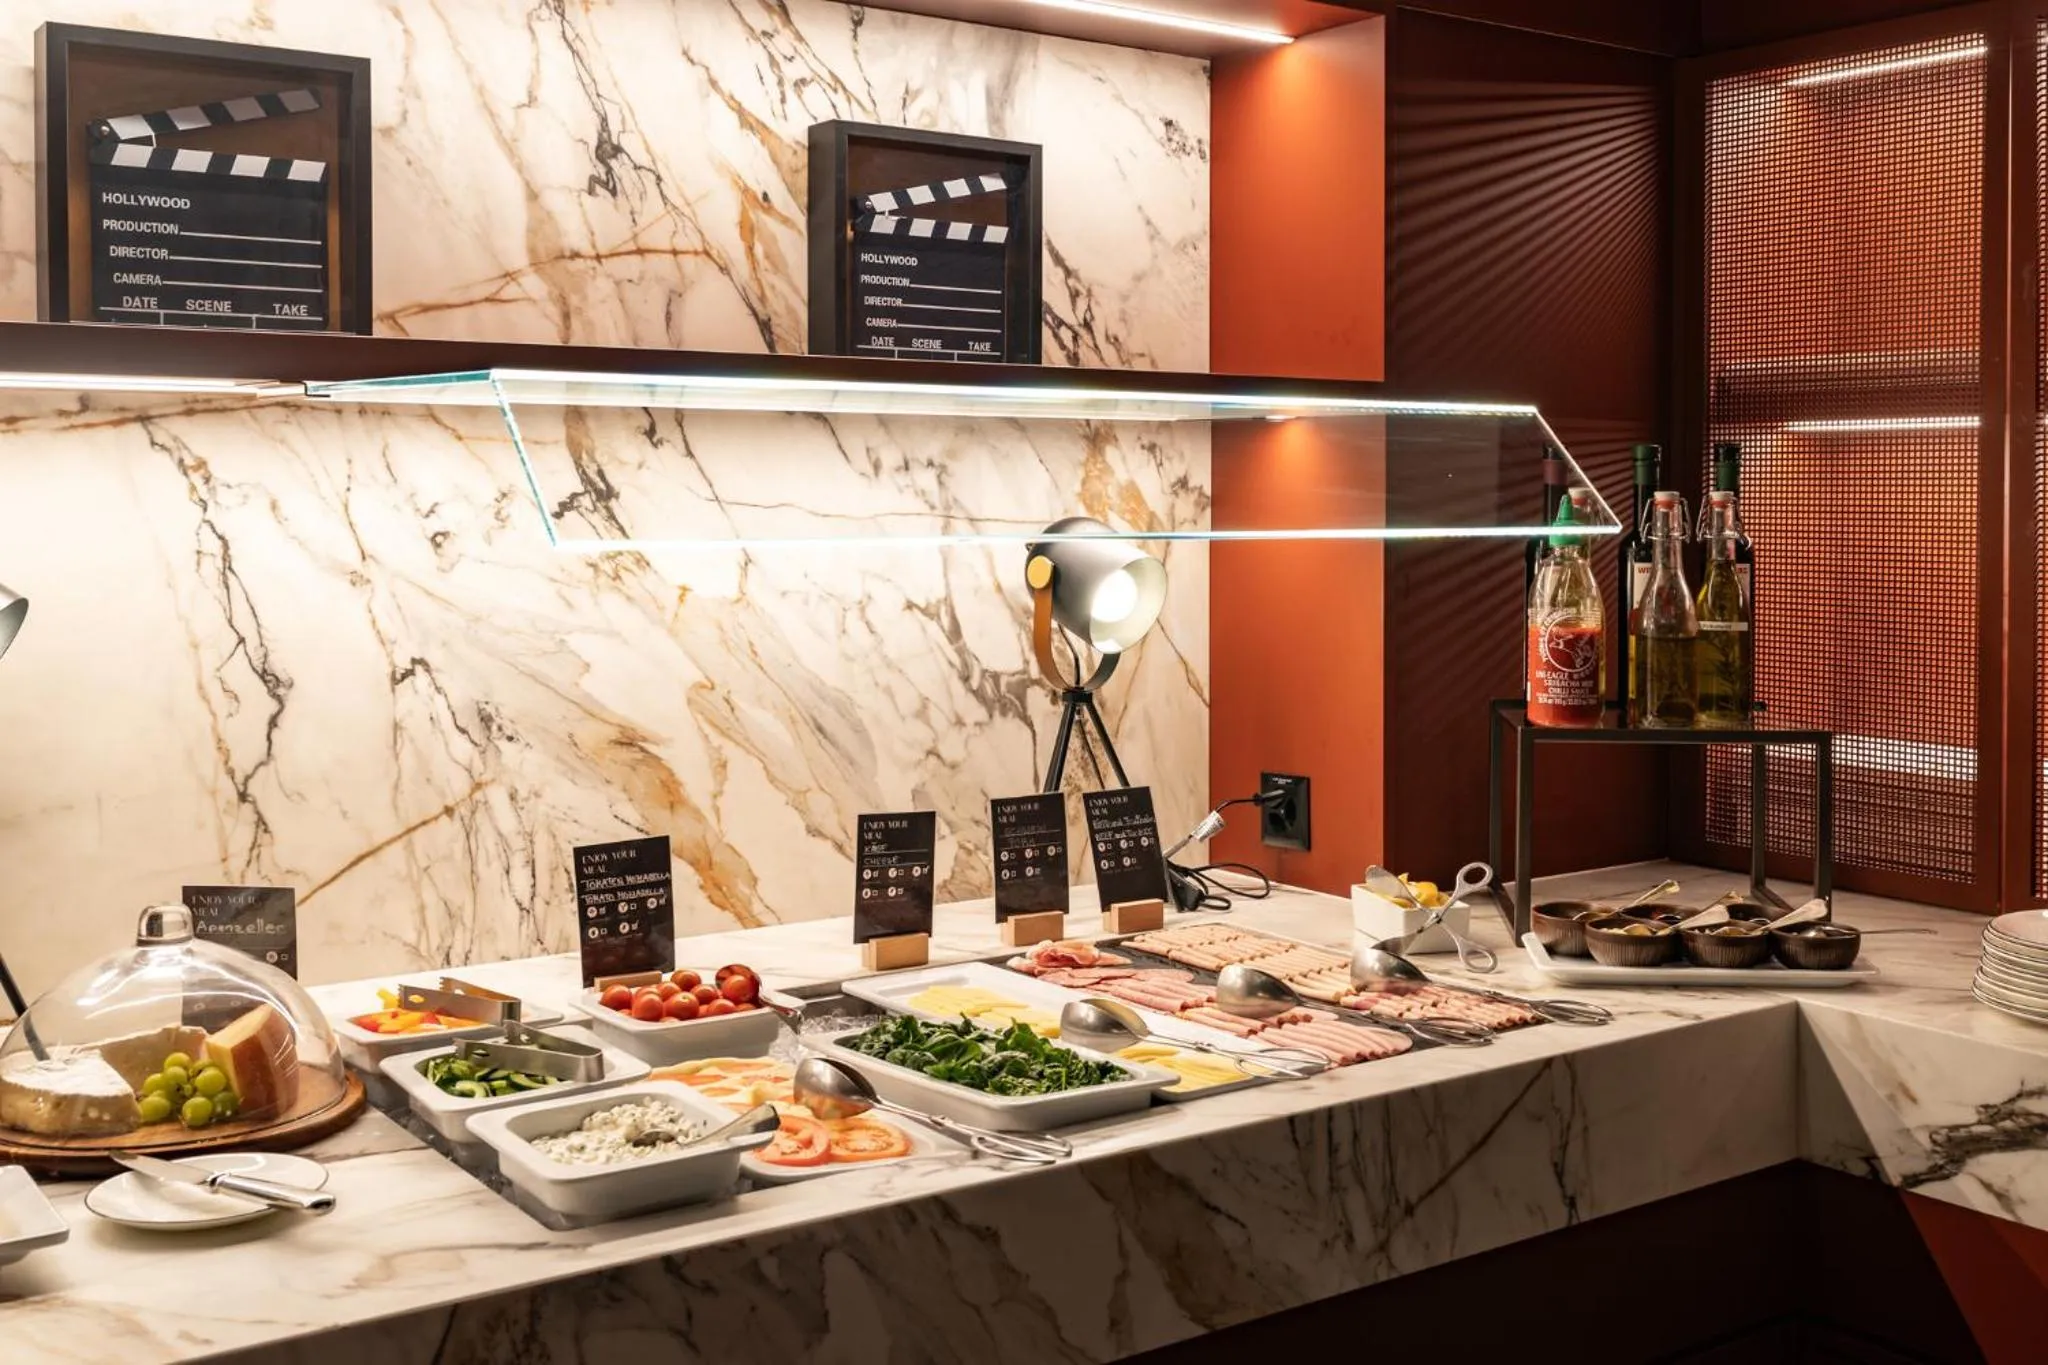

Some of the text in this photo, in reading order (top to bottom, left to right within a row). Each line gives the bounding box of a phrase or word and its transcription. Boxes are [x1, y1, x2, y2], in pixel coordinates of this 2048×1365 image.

[102, 192, 190, 210] HOLLYWOOD
[103, 219, 179, 235] PRODUCTION
[109, 245, 169, 260] DIRECTOR
[861, 253, 918, 267] HOLLYWOOD
[113, 272, 162, 286] CAMERA
[860, 274, 911, 287] PRODUCTION
[122, 296, 309, 316] DATE SCENE TAKE
[864, 296, 902, 307] DIRECTOR
[866, 317, 897, 328] CAMERA
[871, 336, 992, 352] DATE SCENE TAKE
